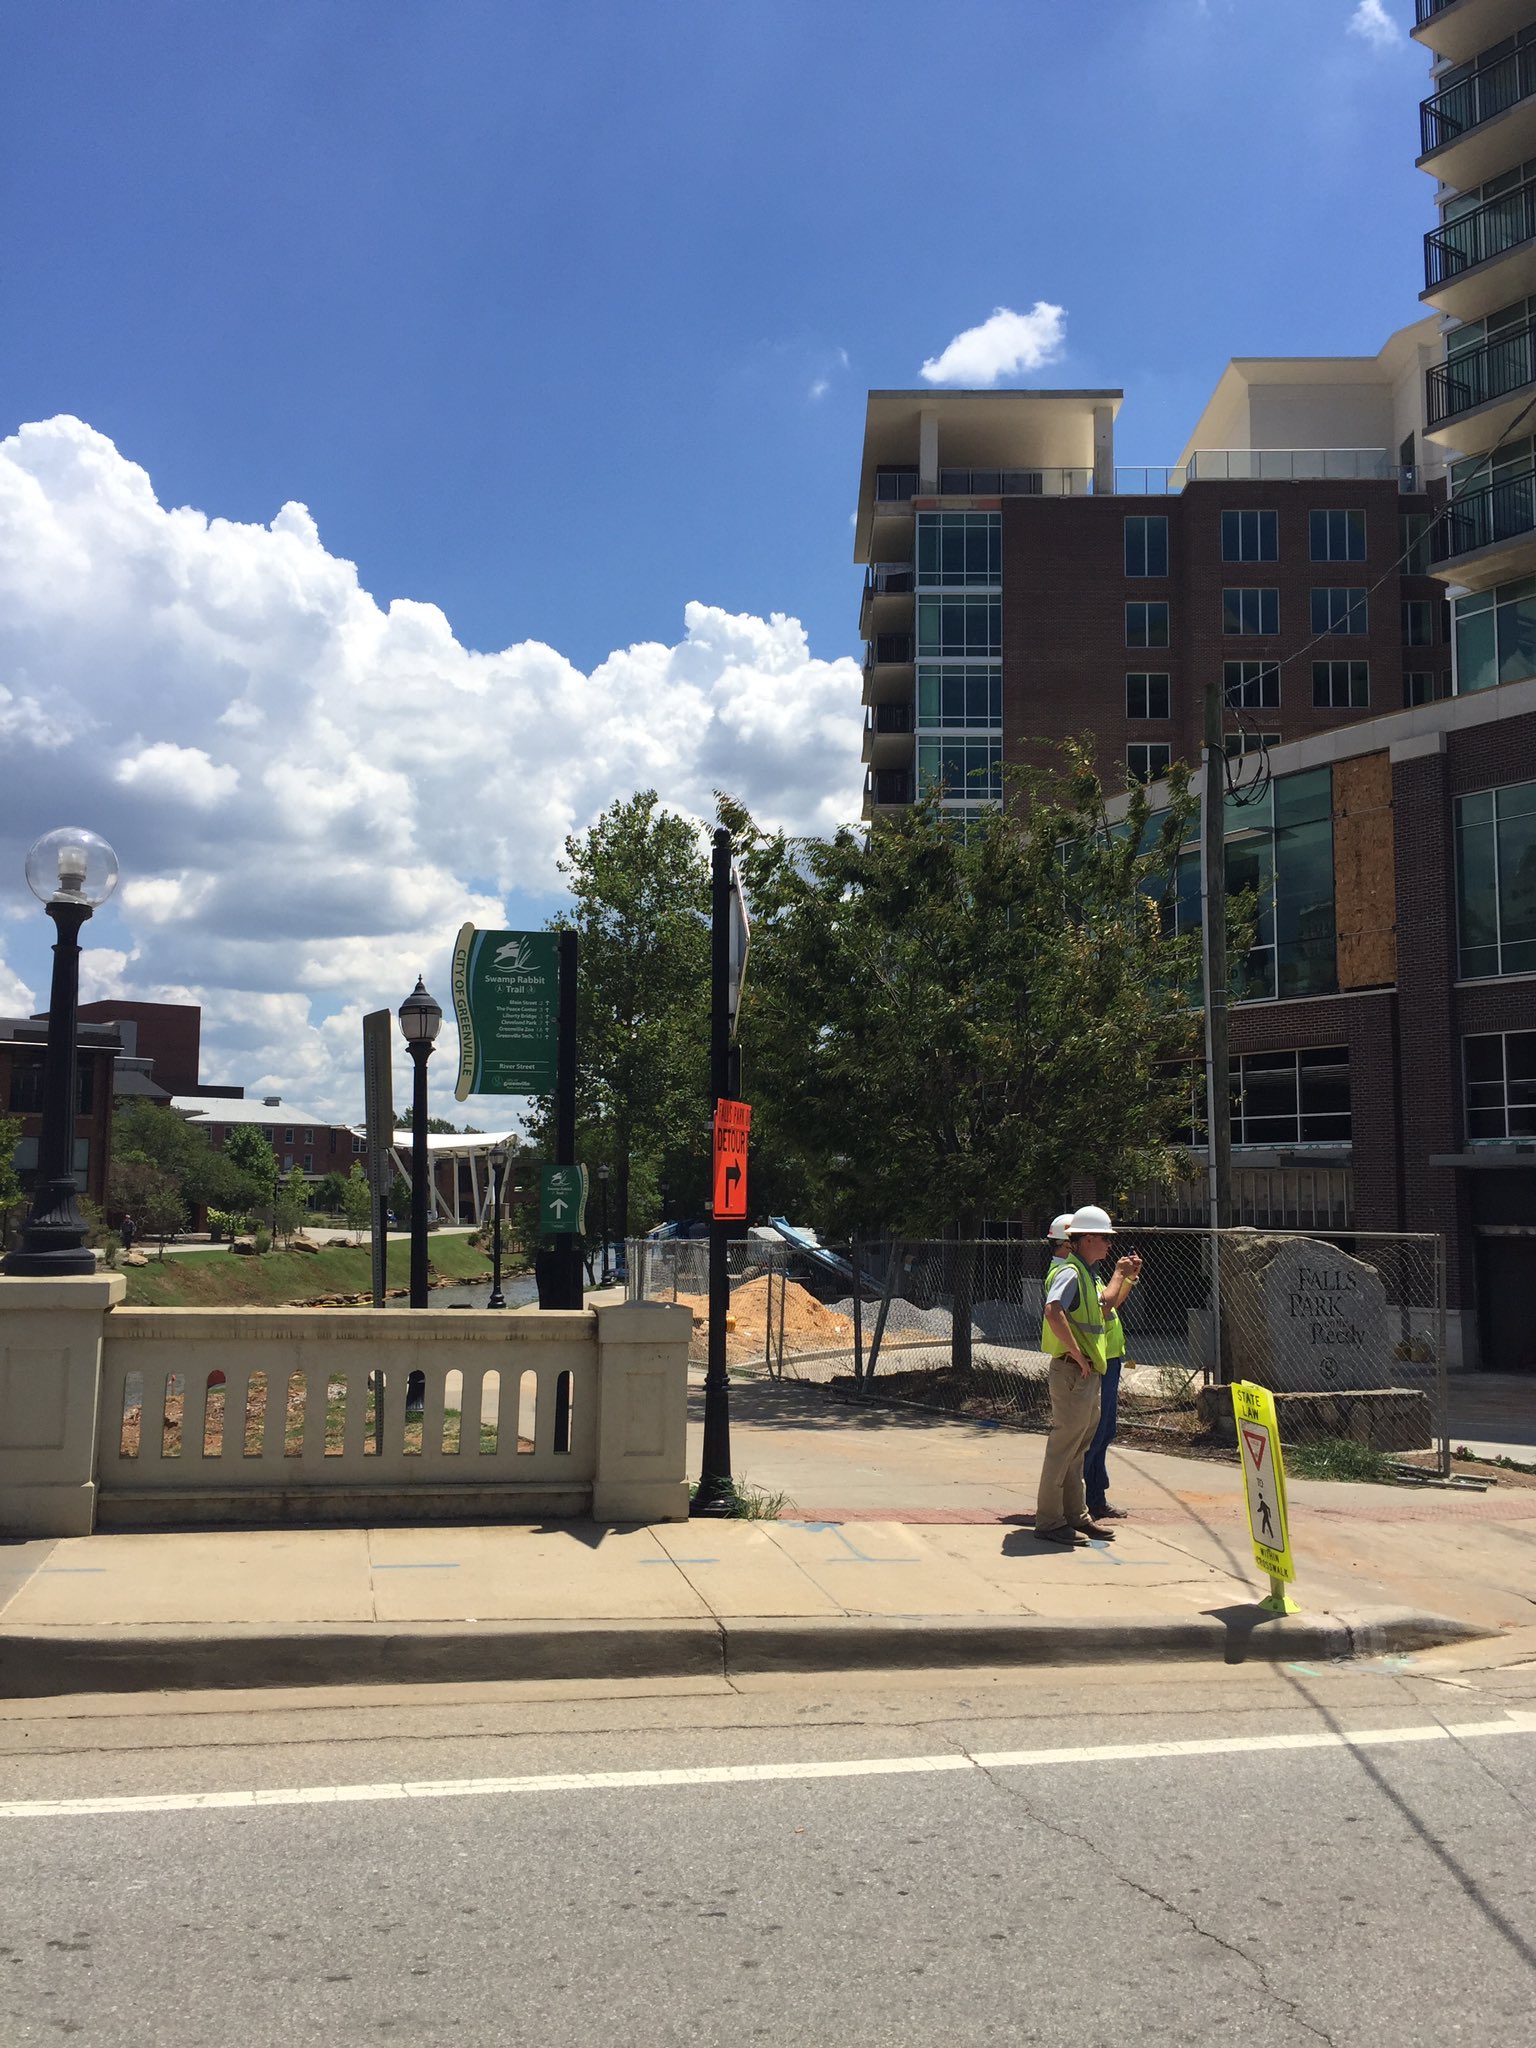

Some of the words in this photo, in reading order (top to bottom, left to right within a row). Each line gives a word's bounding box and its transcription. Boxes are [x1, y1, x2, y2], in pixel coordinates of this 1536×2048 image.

[455, 949, 467, 978] CITY
[455, 981, 466, 997] OF
[484, 975, 516, 985] Swamp
[517, 975, 545, 985] Rabbit
[506, 986, 525, 994] Trail
[456, 999, 473, 1076] GREENVILLE
[717, 1127, 745, 1154] DETOUR
[1298, 1268, 1357, 1291] FALLS
[1288, 1293, 1345, 1317] PARK
[1311, 1322, 1366, 1349] Reedy
[1237, 1389, 1261, 1408] STATE
[1242, 1404, 1260, 1420] LAW
[1256, 1555, 1289, 1578] CROSSWALK
[1260, 1547, 1280, 1563] WITHIN
